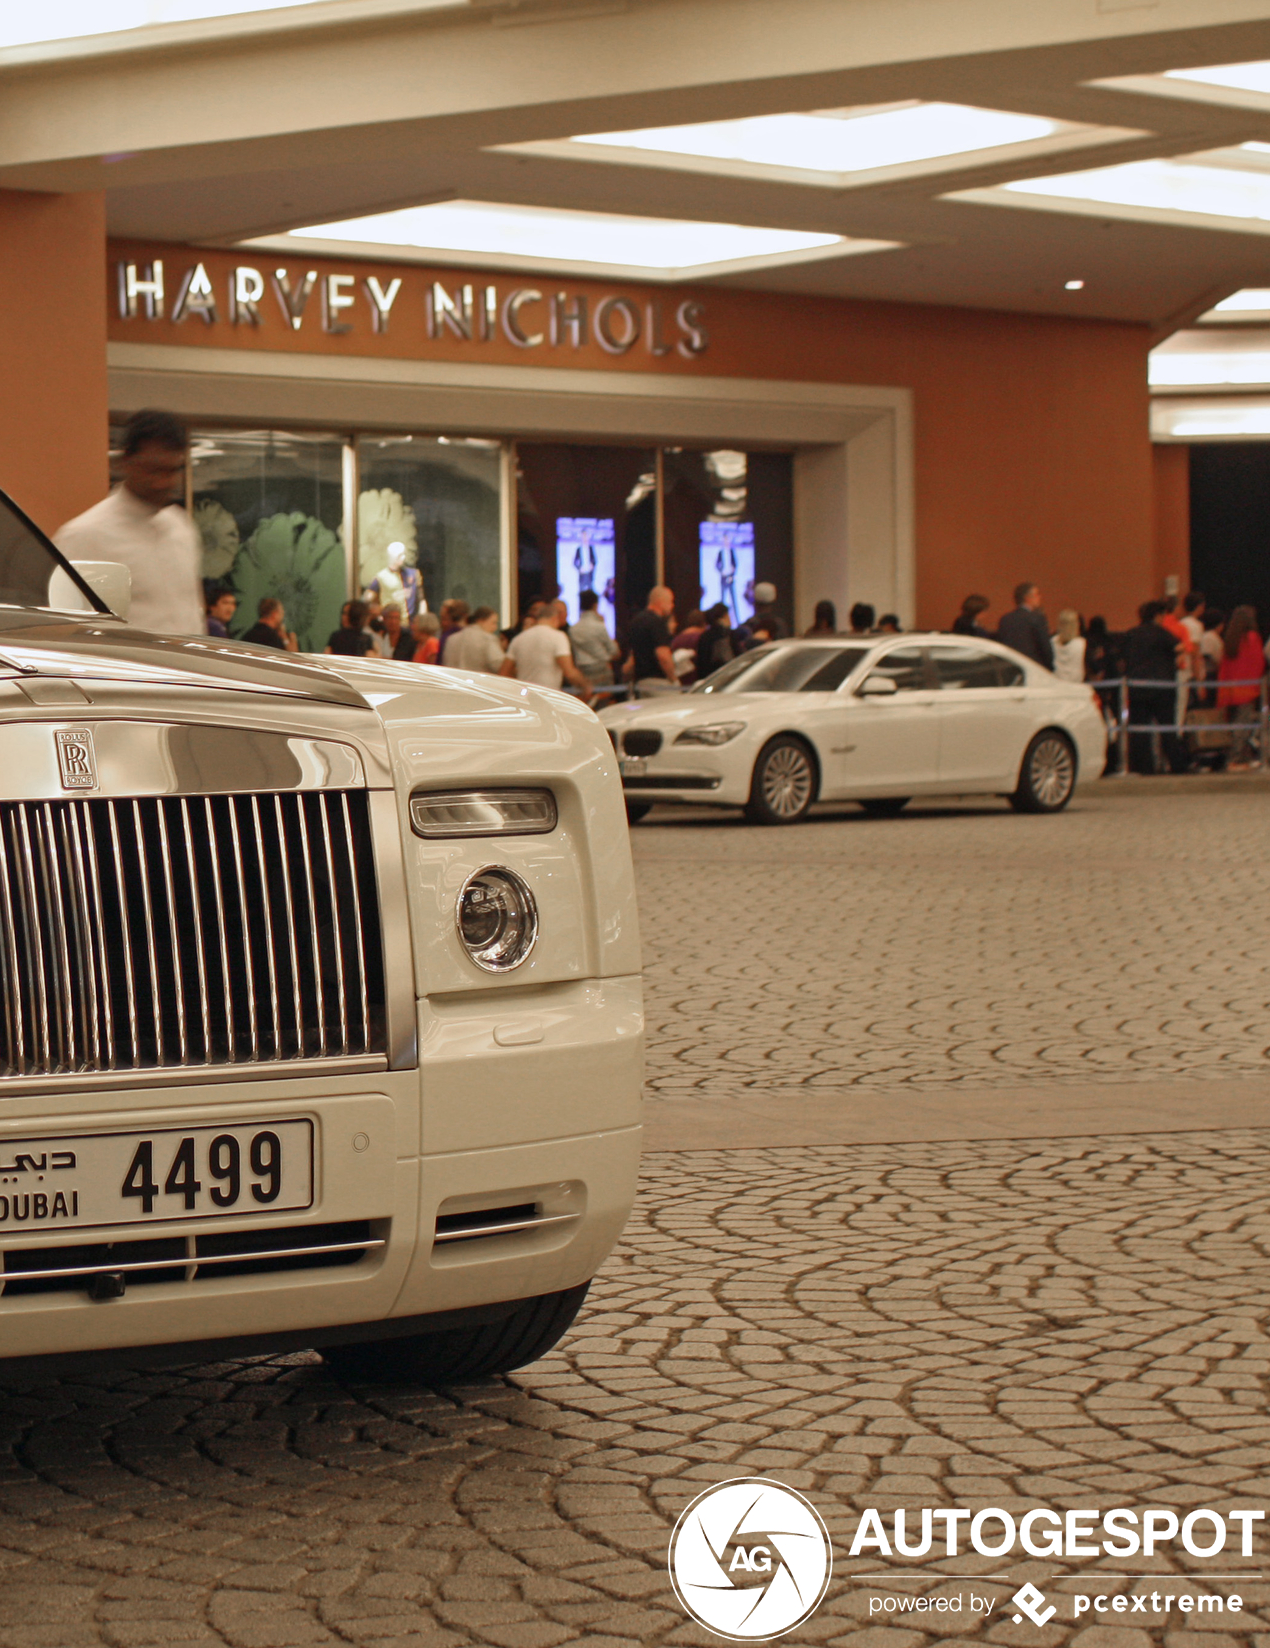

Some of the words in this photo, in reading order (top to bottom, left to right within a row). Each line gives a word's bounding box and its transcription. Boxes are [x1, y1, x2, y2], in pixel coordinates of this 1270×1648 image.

[117, 260, 402, 334] HARVEY
[426, 282, 709, 359] NICHOLS
[121, 1130, 282, 1213] 4499
